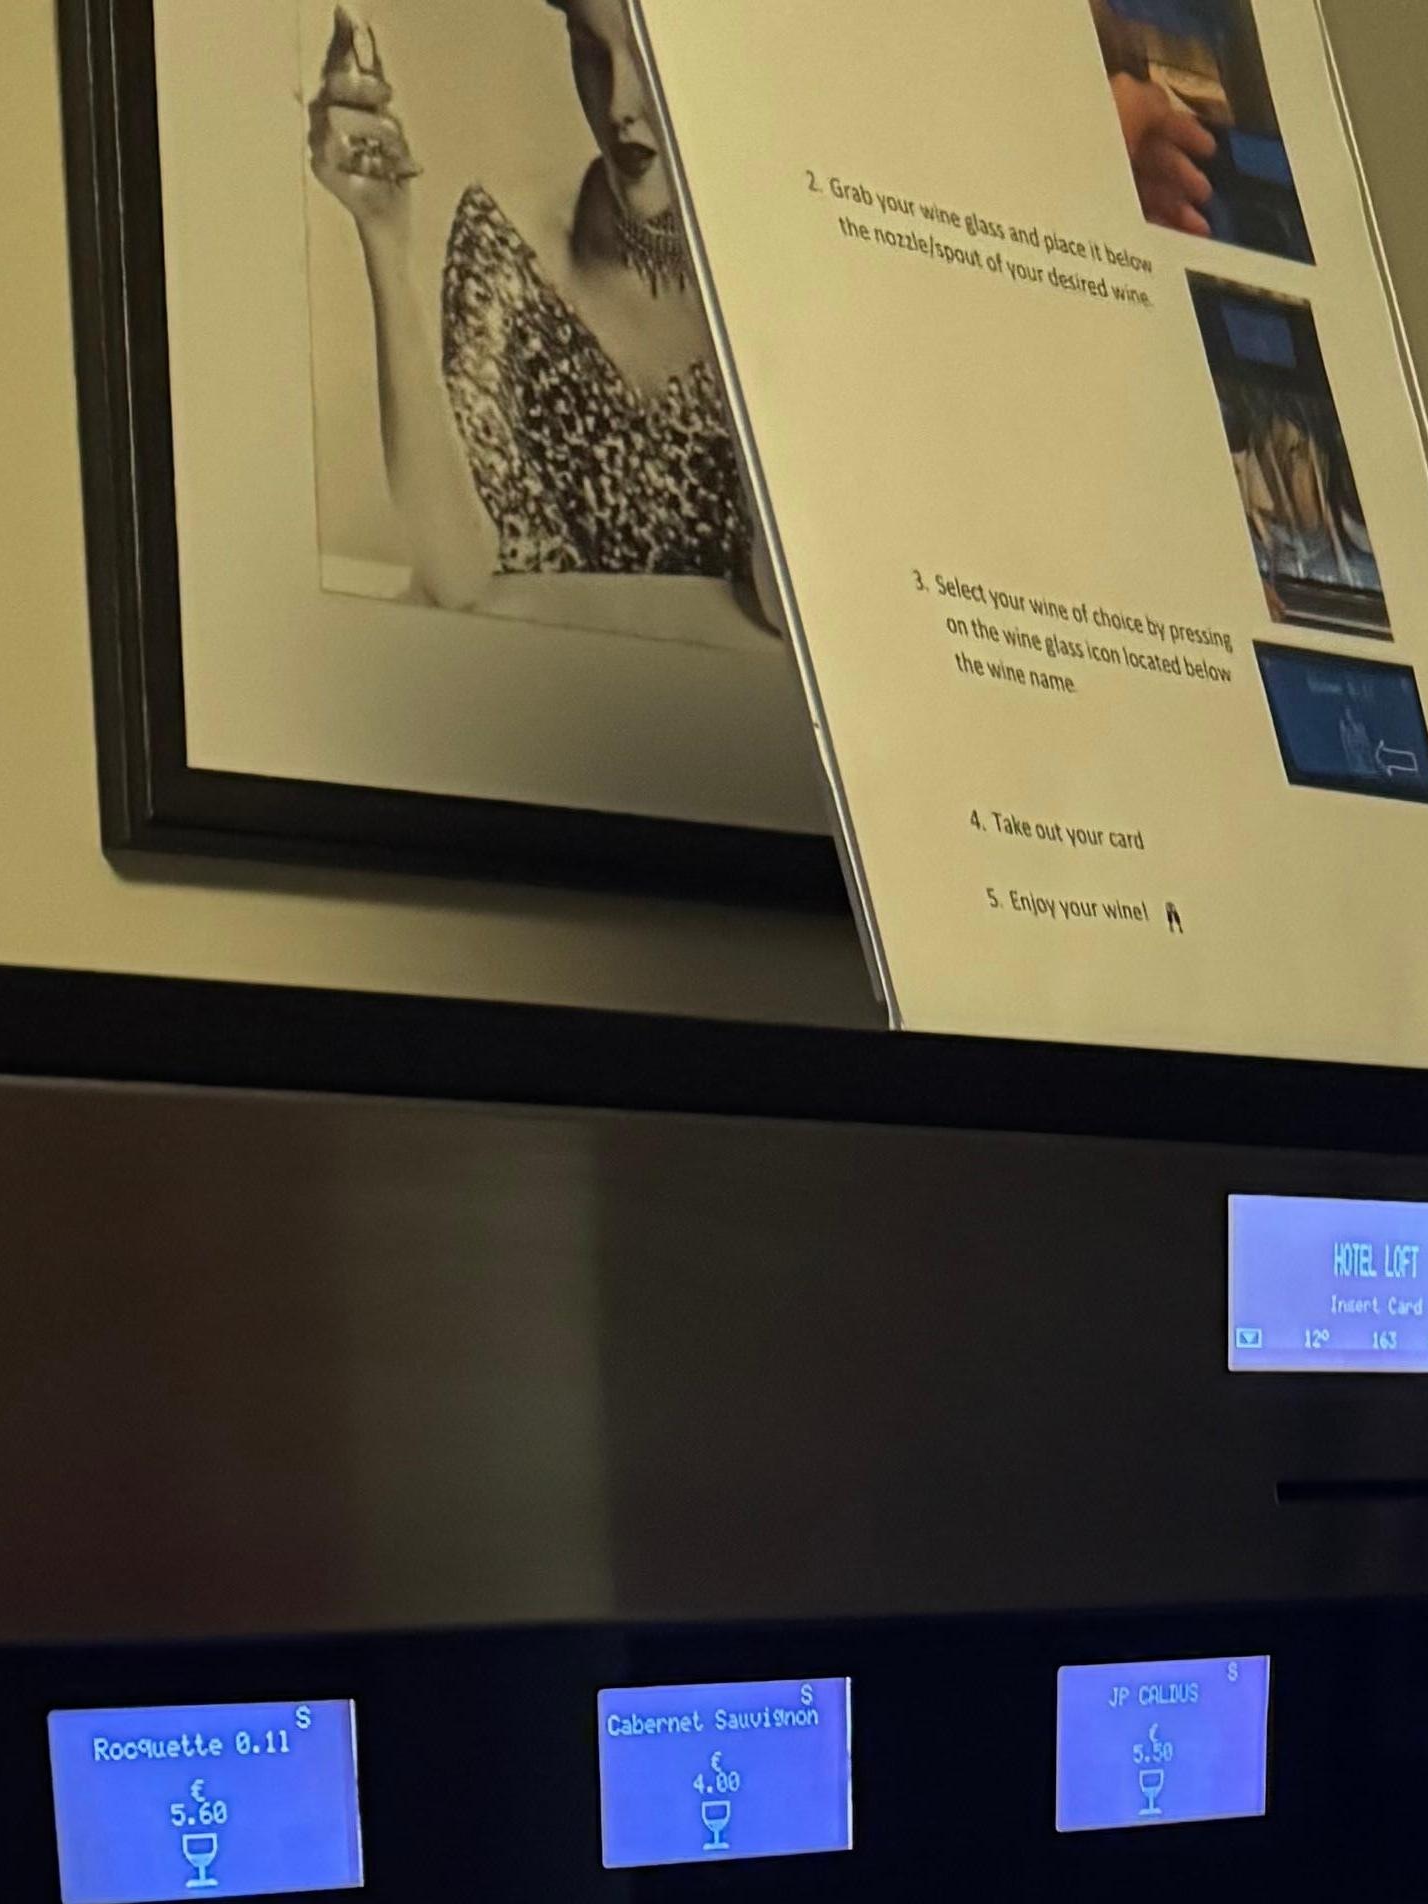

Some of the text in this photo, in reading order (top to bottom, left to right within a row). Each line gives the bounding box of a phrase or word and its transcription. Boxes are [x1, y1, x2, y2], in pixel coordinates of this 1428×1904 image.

[806, 170, 1154, 274] 2. Grab your wine glass and place it below
[839, 216, 871, 241] the
[873, 224, 982, 268] nozzle/spout
[985, 252, 1004, 273] of
[1006, 259, 1044, 283] your
[1048, 267, 1109, 298] desired
[911, 568, 1234, 653] 3. Select your wine of choice by pressing
[946, 616, 1232, 683] on the wine glass icon located below
[954, 652, 985, 676] the
[986, 662, 1026, 685] wine
[970, 809, 1145, 851] 4. Take out your card
[986, 887, 1150, 921] 5. Enjoy your wine!
[1333, 1242, 1420, 1279] HOTEL LOFT
[1330, 1294, 1423, 1316] Insert Card
[800, 1684, 813, 1705] S
[1108, 1687, 1129, 1707] JP
[295, 1705, 311, 1729] S
[607, 1706, 819, 1737] Cabernet Sauvignon
[236, 1730, 290, 1756] 0.11
[693, 1771, 740, 1793] 4.00
[171, 1801, 227, 1826] 5.60
